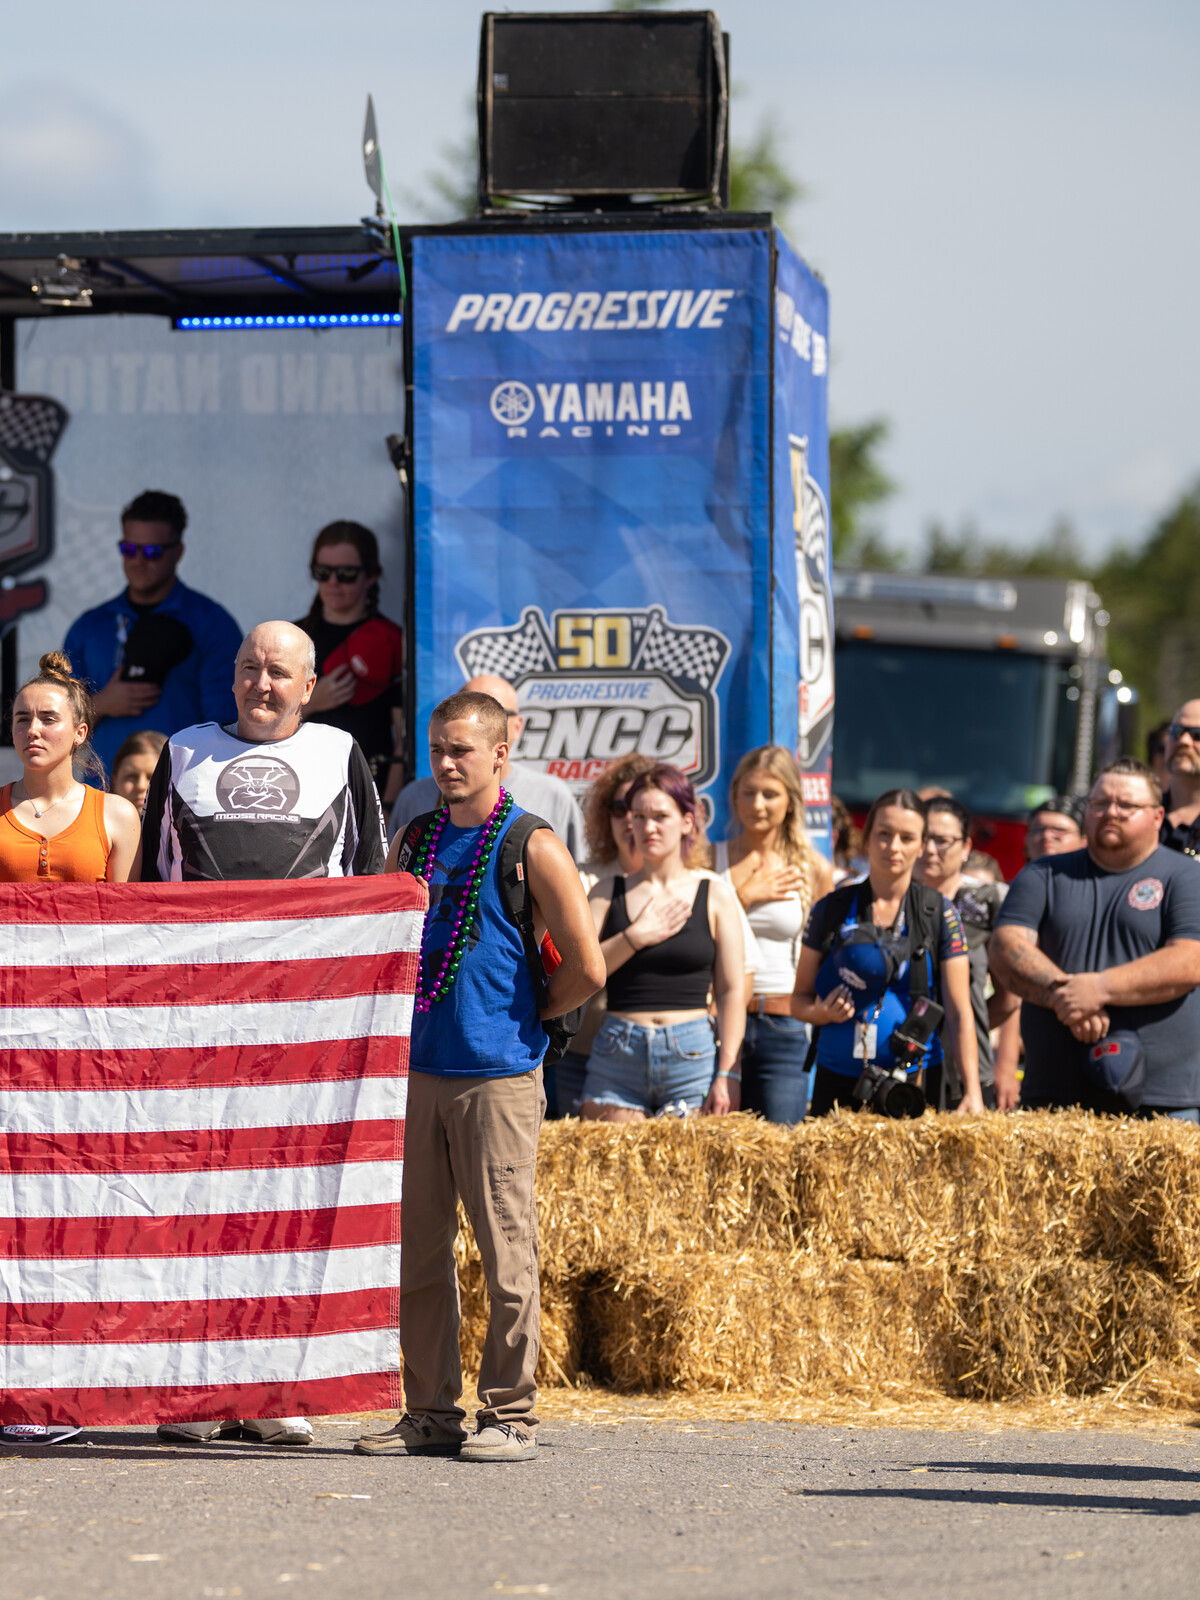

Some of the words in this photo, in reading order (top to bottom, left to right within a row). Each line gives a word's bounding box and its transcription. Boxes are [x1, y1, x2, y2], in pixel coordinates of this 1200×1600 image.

[446, 289, 736, 333] PROGRESSIVE
[536, 381, 693, 423] YAMAHA
[507, 425, 682, 438] RACING
[557, 615, 632, 669] 50
[527, 682, 652, 700] PROGRESSIVE
[513, 705, 693, 761] GNCC
[215, 813, 256, 821] MOOSE
[257, 813, 299, 823] RACING
